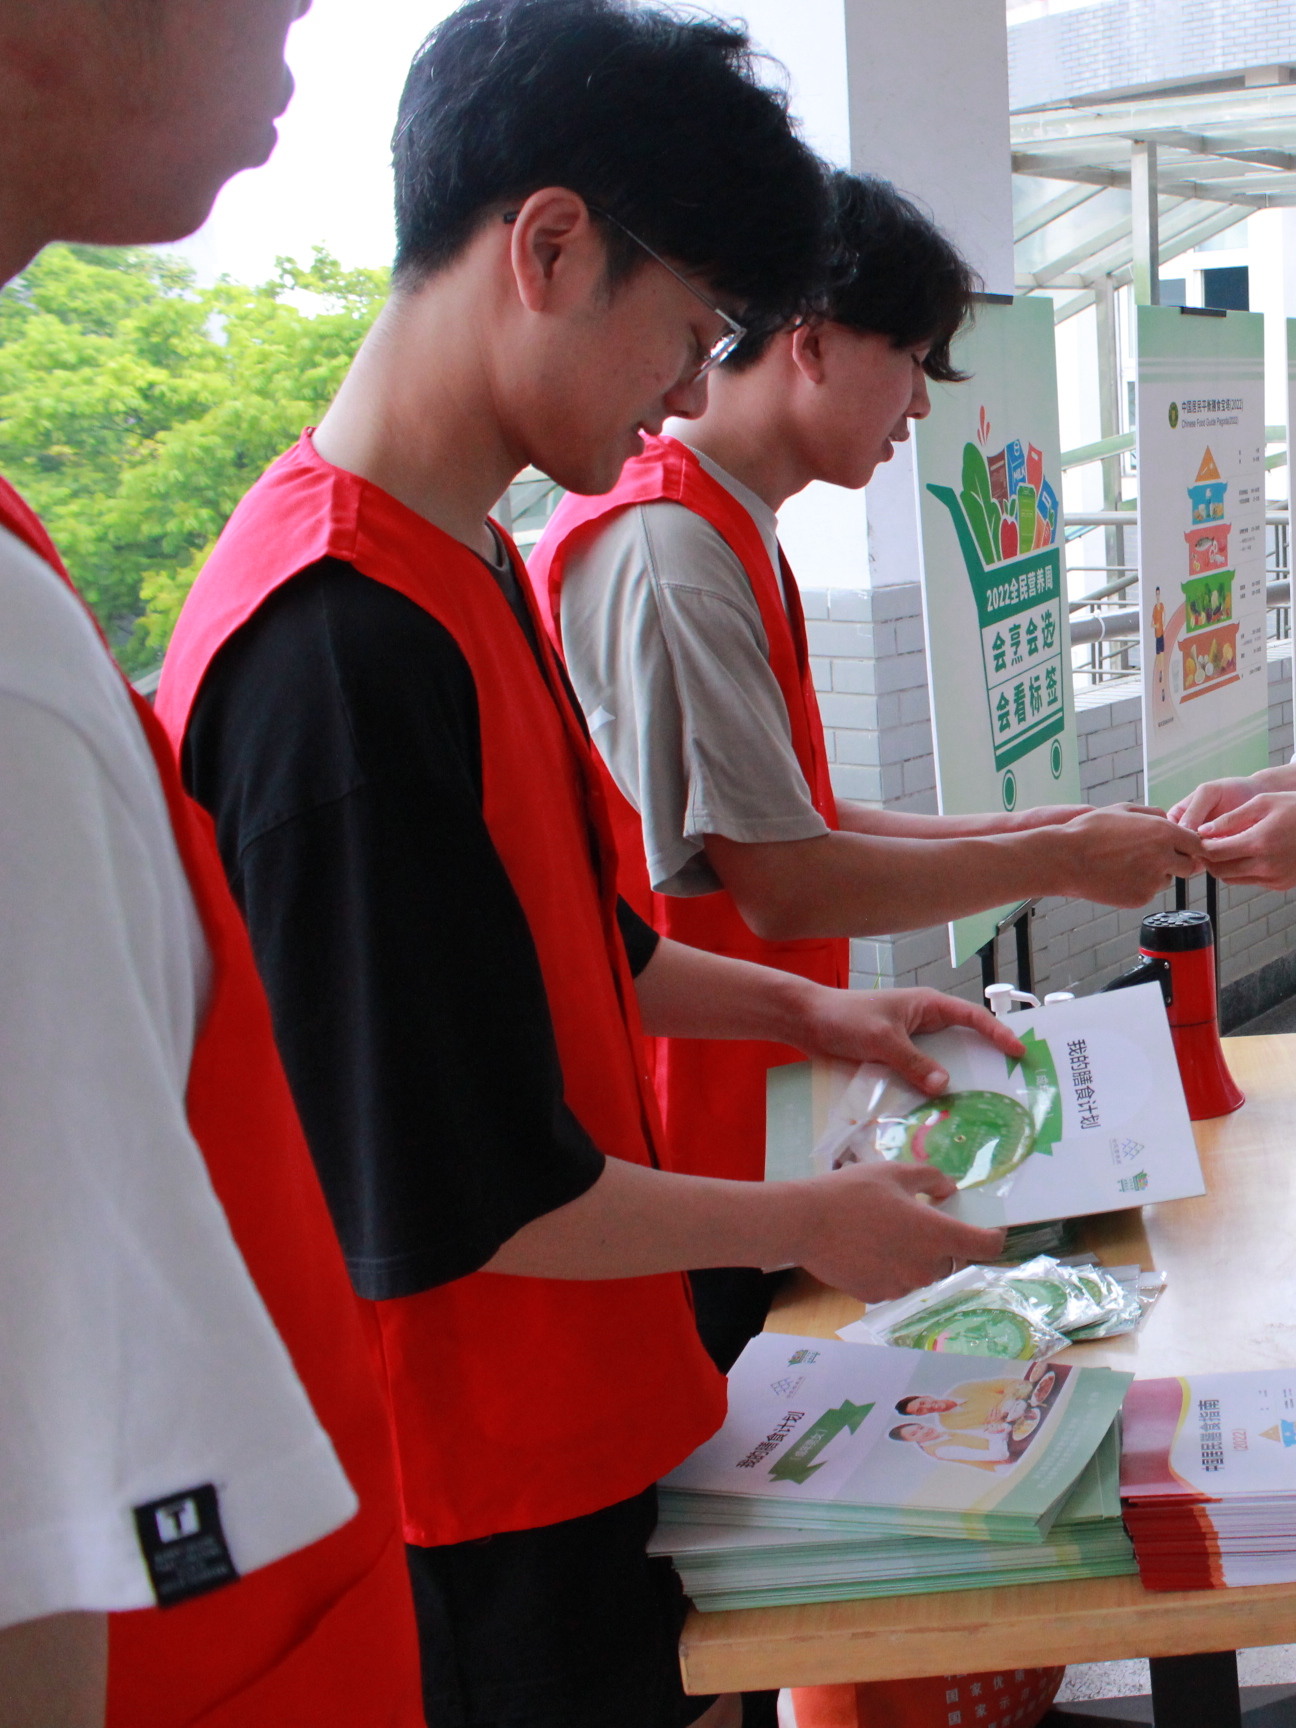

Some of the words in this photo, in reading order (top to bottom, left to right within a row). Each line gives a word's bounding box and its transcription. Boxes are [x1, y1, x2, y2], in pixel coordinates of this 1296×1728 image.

[986, 566, 1054, 612] 2022全民营养周
[992, 608, 1056, 675] 会烹会选
[996, 665, 1059, 735] 会看标签
[1067, 1038, 1102, 1130] 我的膳食计划
[1198, 1398, 1226, 1473] 中国居民膳食指南
